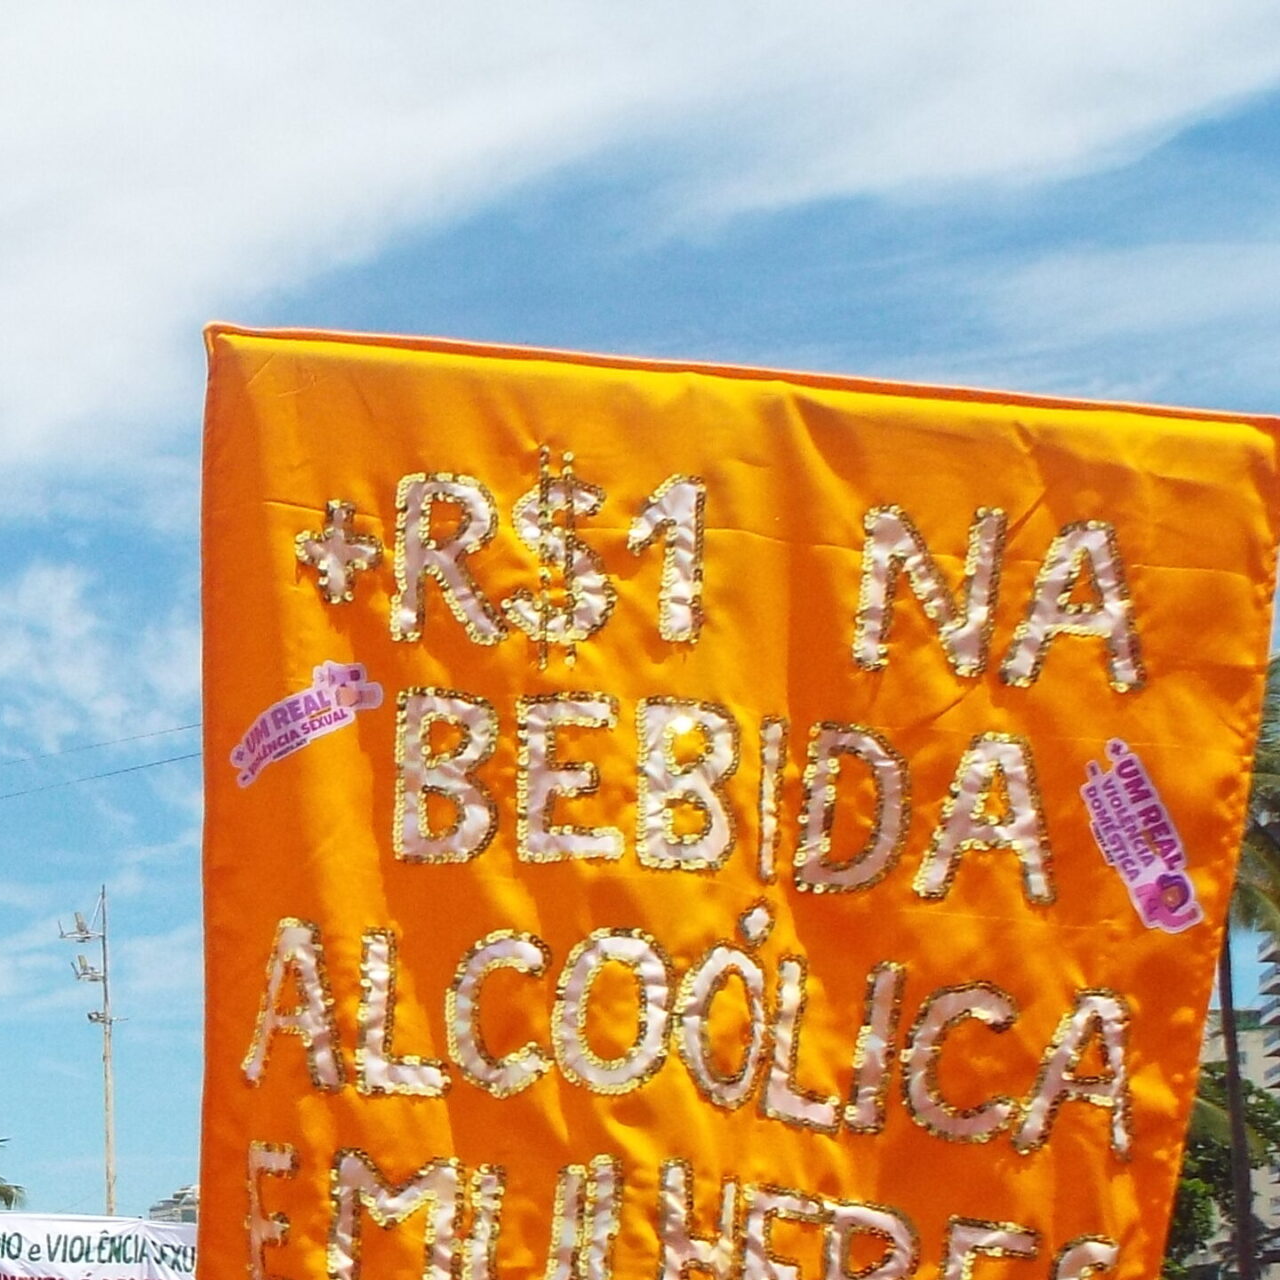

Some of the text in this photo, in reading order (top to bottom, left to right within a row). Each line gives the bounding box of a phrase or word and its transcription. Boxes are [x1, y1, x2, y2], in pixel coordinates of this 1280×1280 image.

[854, 503, 1146, 693] NA
[246, 718, 270, 753] UM
[270, 690, 331, 730] REAL
[301, 709, 348, 735] SEXUAL
[392, 684, 1059, 907] BEBIDA
[1116, 759, 1152, 804] UM
[1137, 804, 1183, 871] REAL
[28, 1243, 40, 1261] e
[47, 1229, 149, 1264] VIOLÊNCIA
